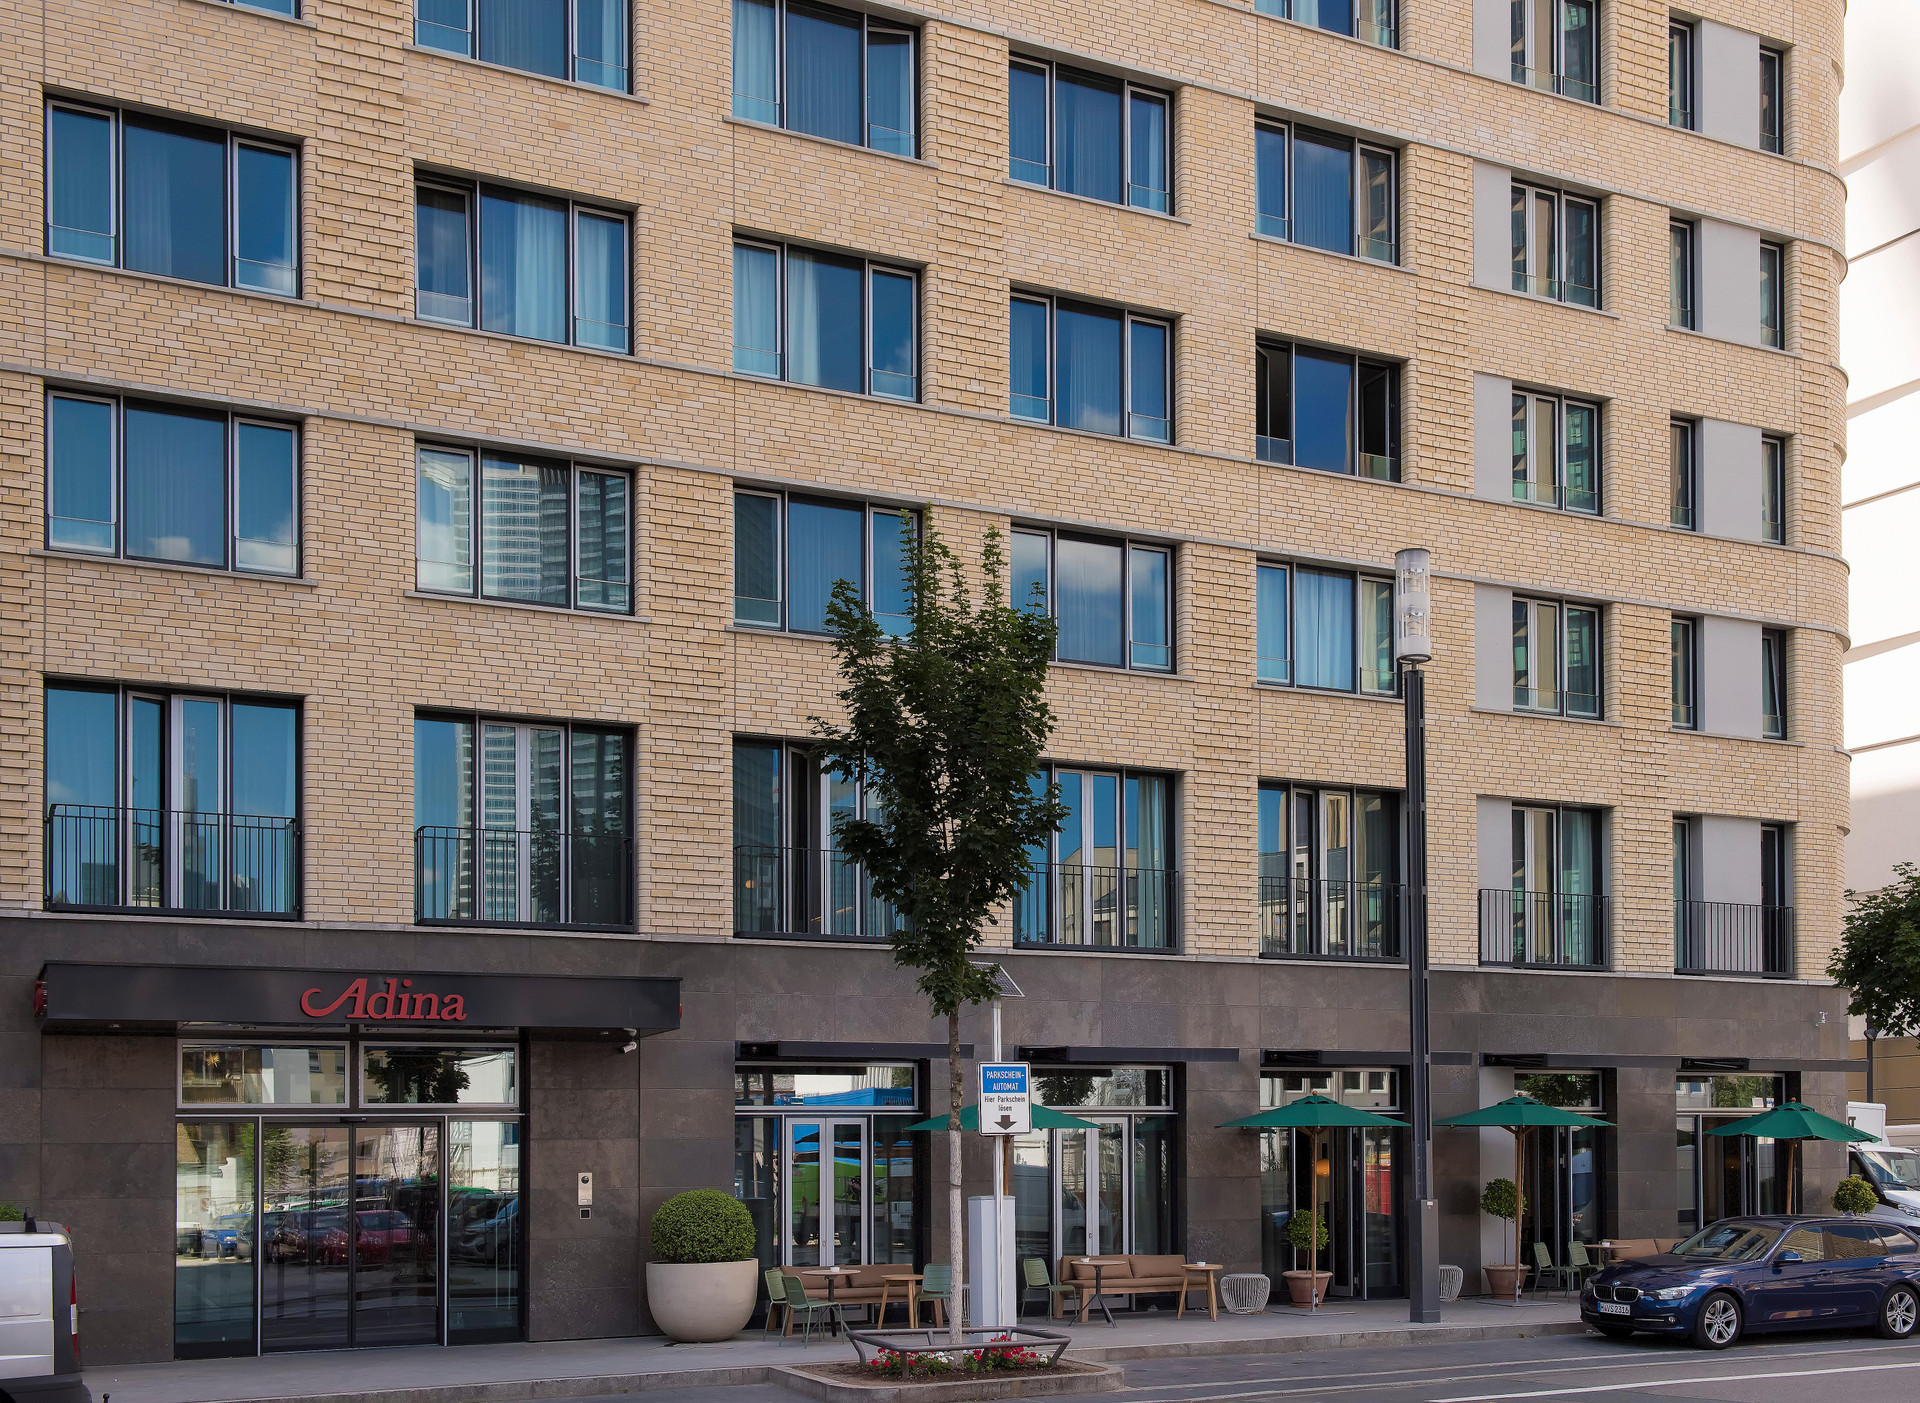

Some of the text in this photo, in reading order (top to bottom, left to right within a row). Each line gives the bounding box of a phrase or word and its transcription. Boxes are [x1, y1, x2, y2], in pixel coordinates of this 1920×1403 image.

[300, 978, 467, 1021] Adina
[986, 1071, 1024, 1079] PARKSCHEIN-
[992, 1082, 1019, 1091] AUTOMAT
